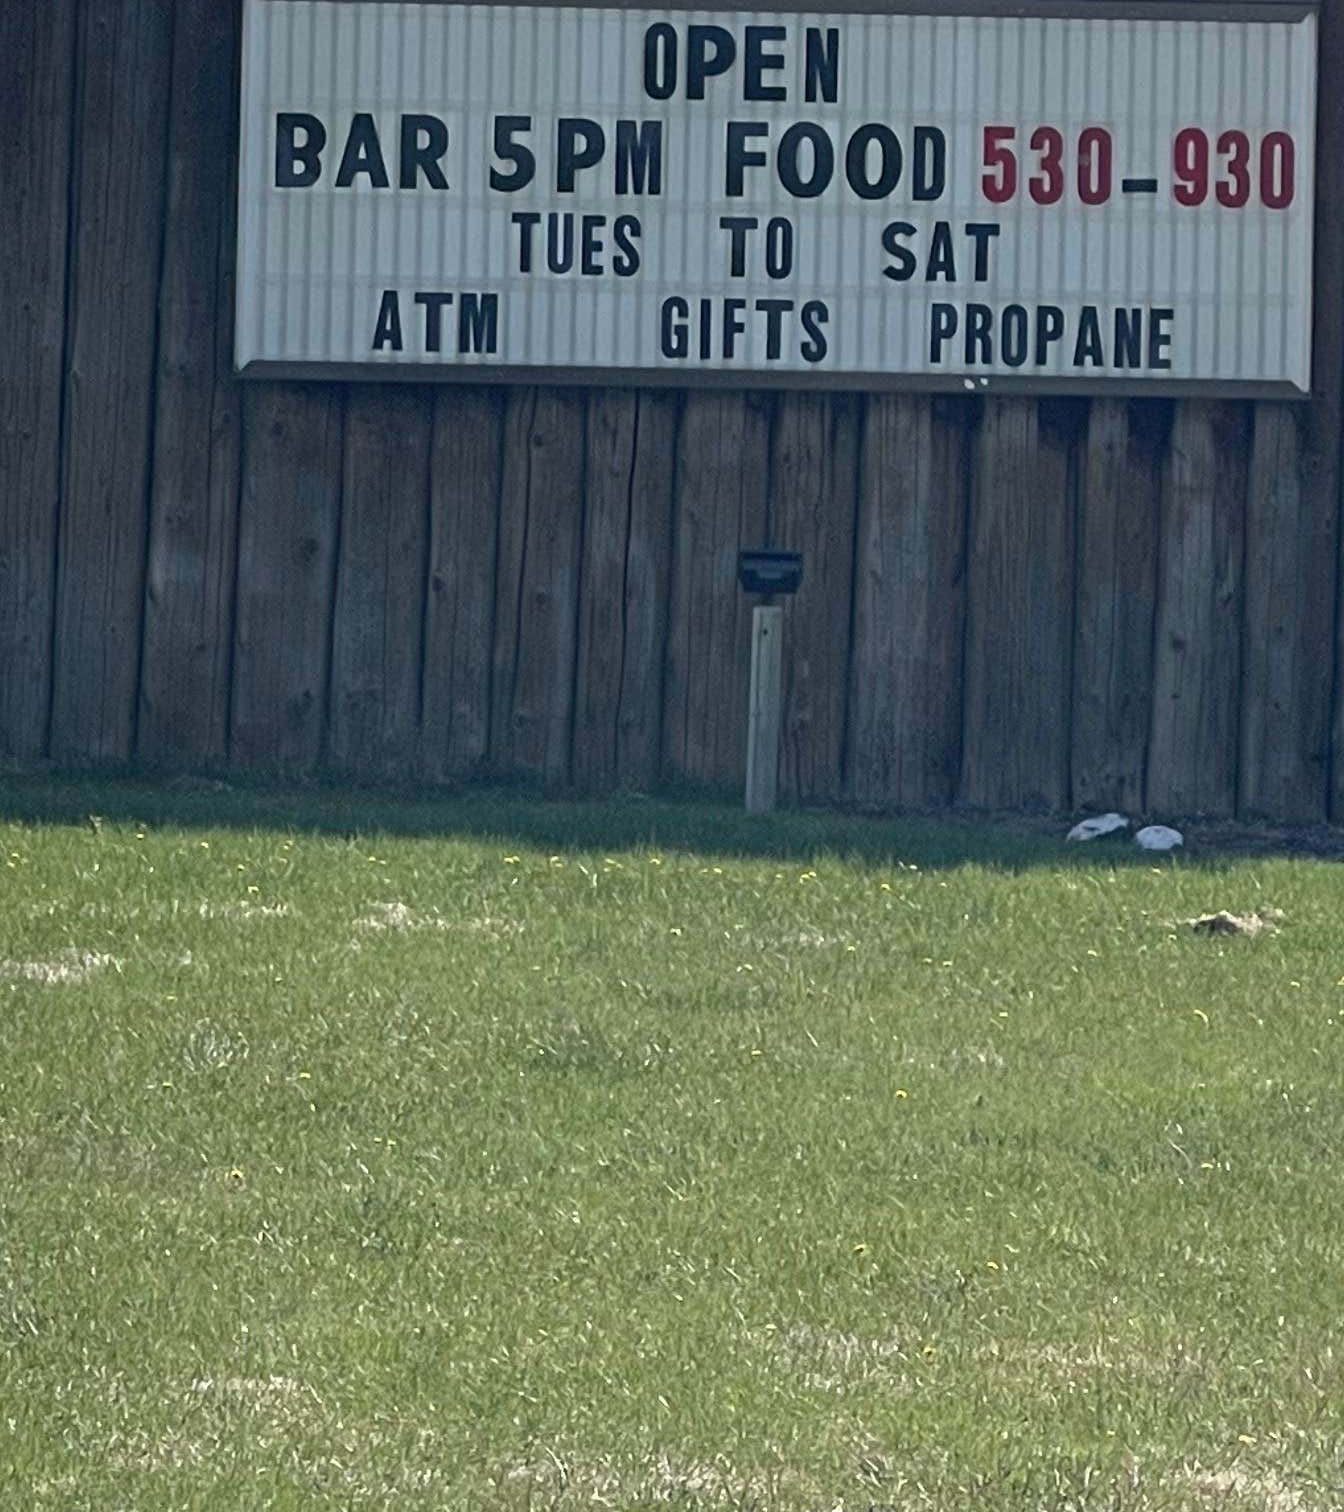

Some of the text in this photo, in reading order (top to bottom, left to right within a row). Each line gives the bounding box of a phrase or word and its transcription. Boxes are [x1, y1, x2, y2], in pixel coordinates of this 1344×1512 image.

[643, 21, 840, 104] OPEN
[274, 112, 451, 190] BAR
[724, 120, 948, 202] FOOD
[511, 212, 1001, 282] TUES TO SAT
[372, 289, 1175, 370] ATM GIFTS PROPANE
